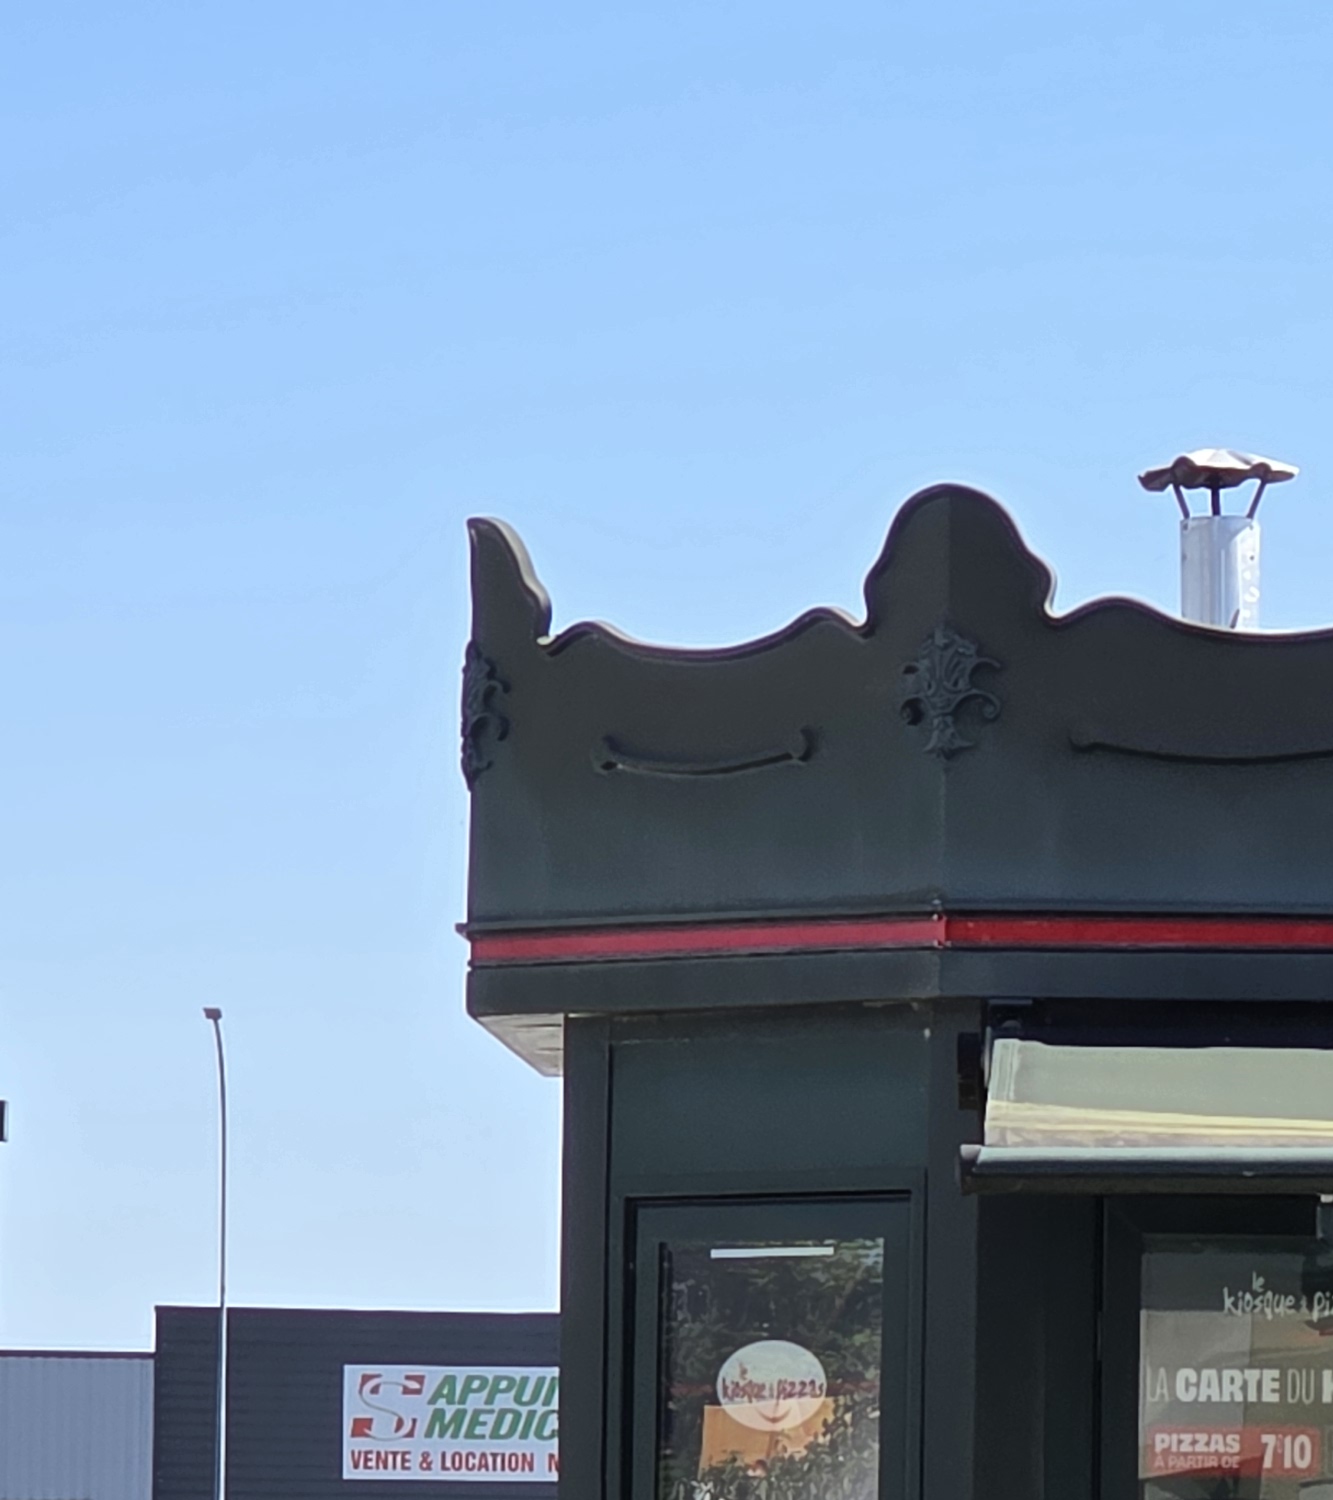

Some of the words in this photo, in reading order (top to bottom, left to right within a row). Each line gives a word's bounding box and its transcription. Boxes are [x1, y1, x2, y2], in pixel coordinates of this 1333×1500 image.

[1223, 1286, 1296, 1321] kiosque
[1149, 1367, 1168, 1401] LA
[1176, 1368, 1281, 1402] CARTE
[1287, 1369, 1316, 1403] DU
[1155, 1433, 1240, 1454] PIZZAS
[351, 1450, 411, 1470] VENTE
[419, 1451, 433, 1471] &
[440, 1452, 534, 1472] LOCATION
[1168, 1455, 1218, 1469] PARTIR
